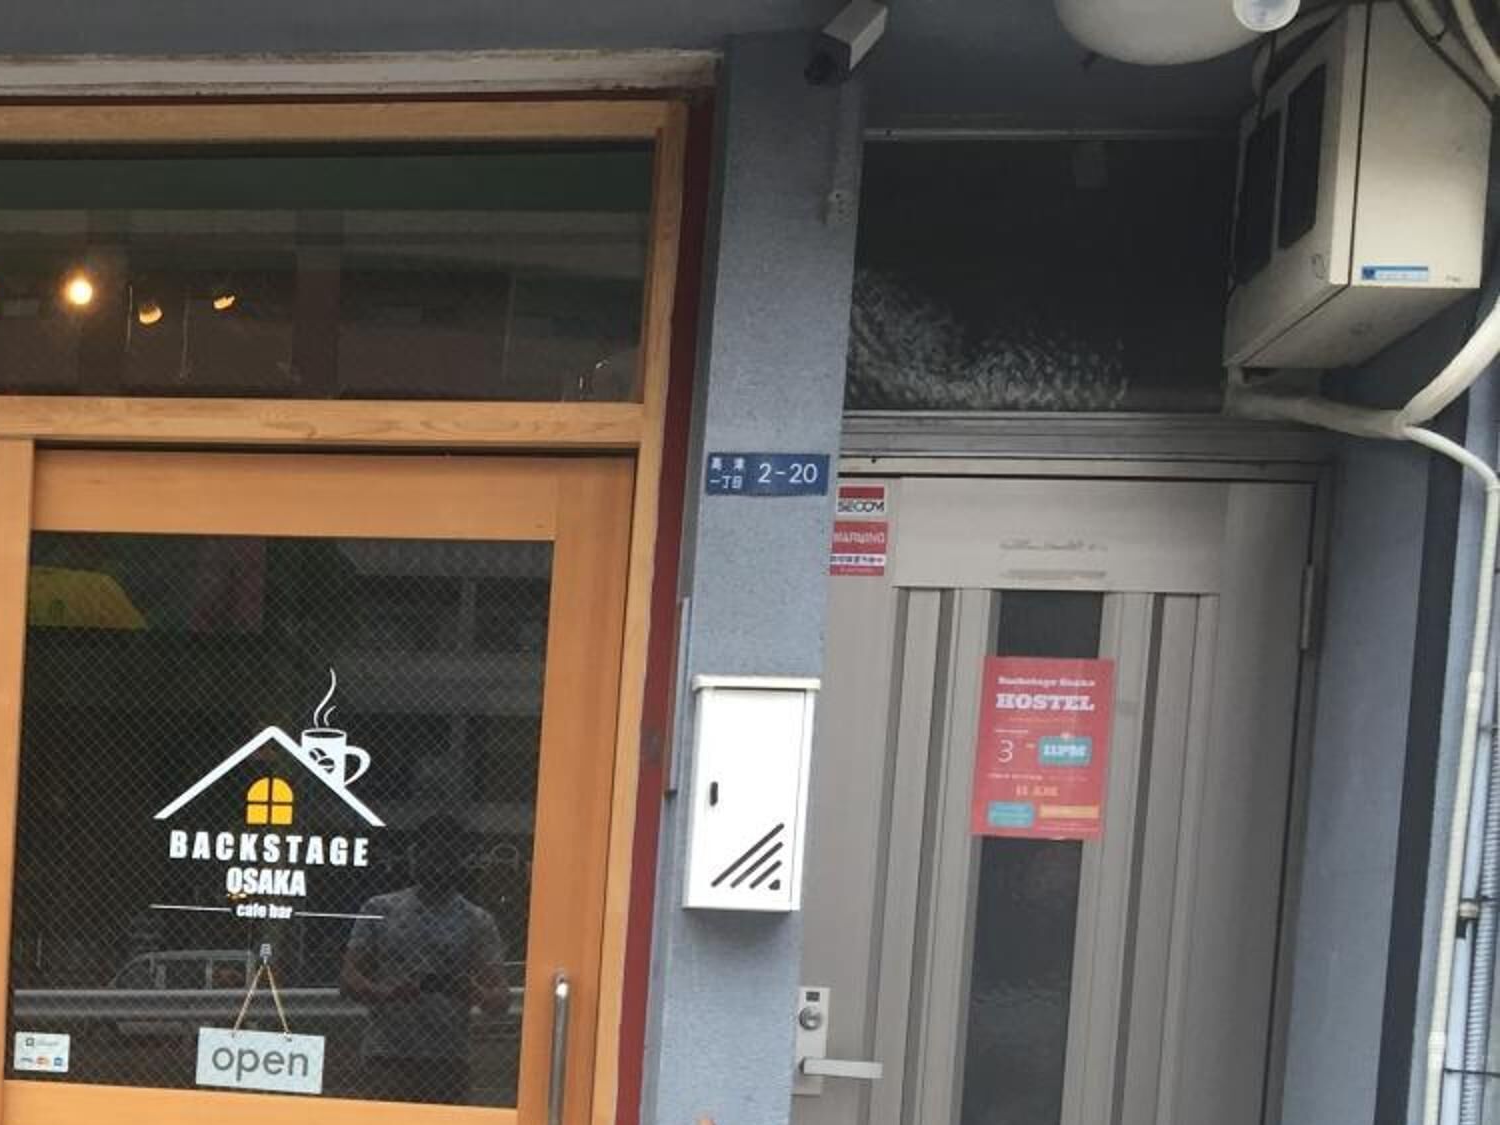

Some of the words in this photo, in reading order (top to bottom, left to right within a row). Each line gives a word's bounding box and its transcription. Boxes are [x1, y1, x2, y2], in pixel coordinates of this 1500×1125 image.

[710, 475, 744, 490] 一丁目
[757, 463, 819, 484] 2-20
[837, 500, 886, 513] SECOM
[995, 693, 1095, 712] HOSTEL
[997, 739, 1014, 763] 3
[169, 829, 370, 867] BACKSTAGE
[226, 866, 307, 897] OSAKA
[235, 903, 267, 918] cafe
[269, 904, 293, 919] bar
[211, 1047, 310, 1082] open
